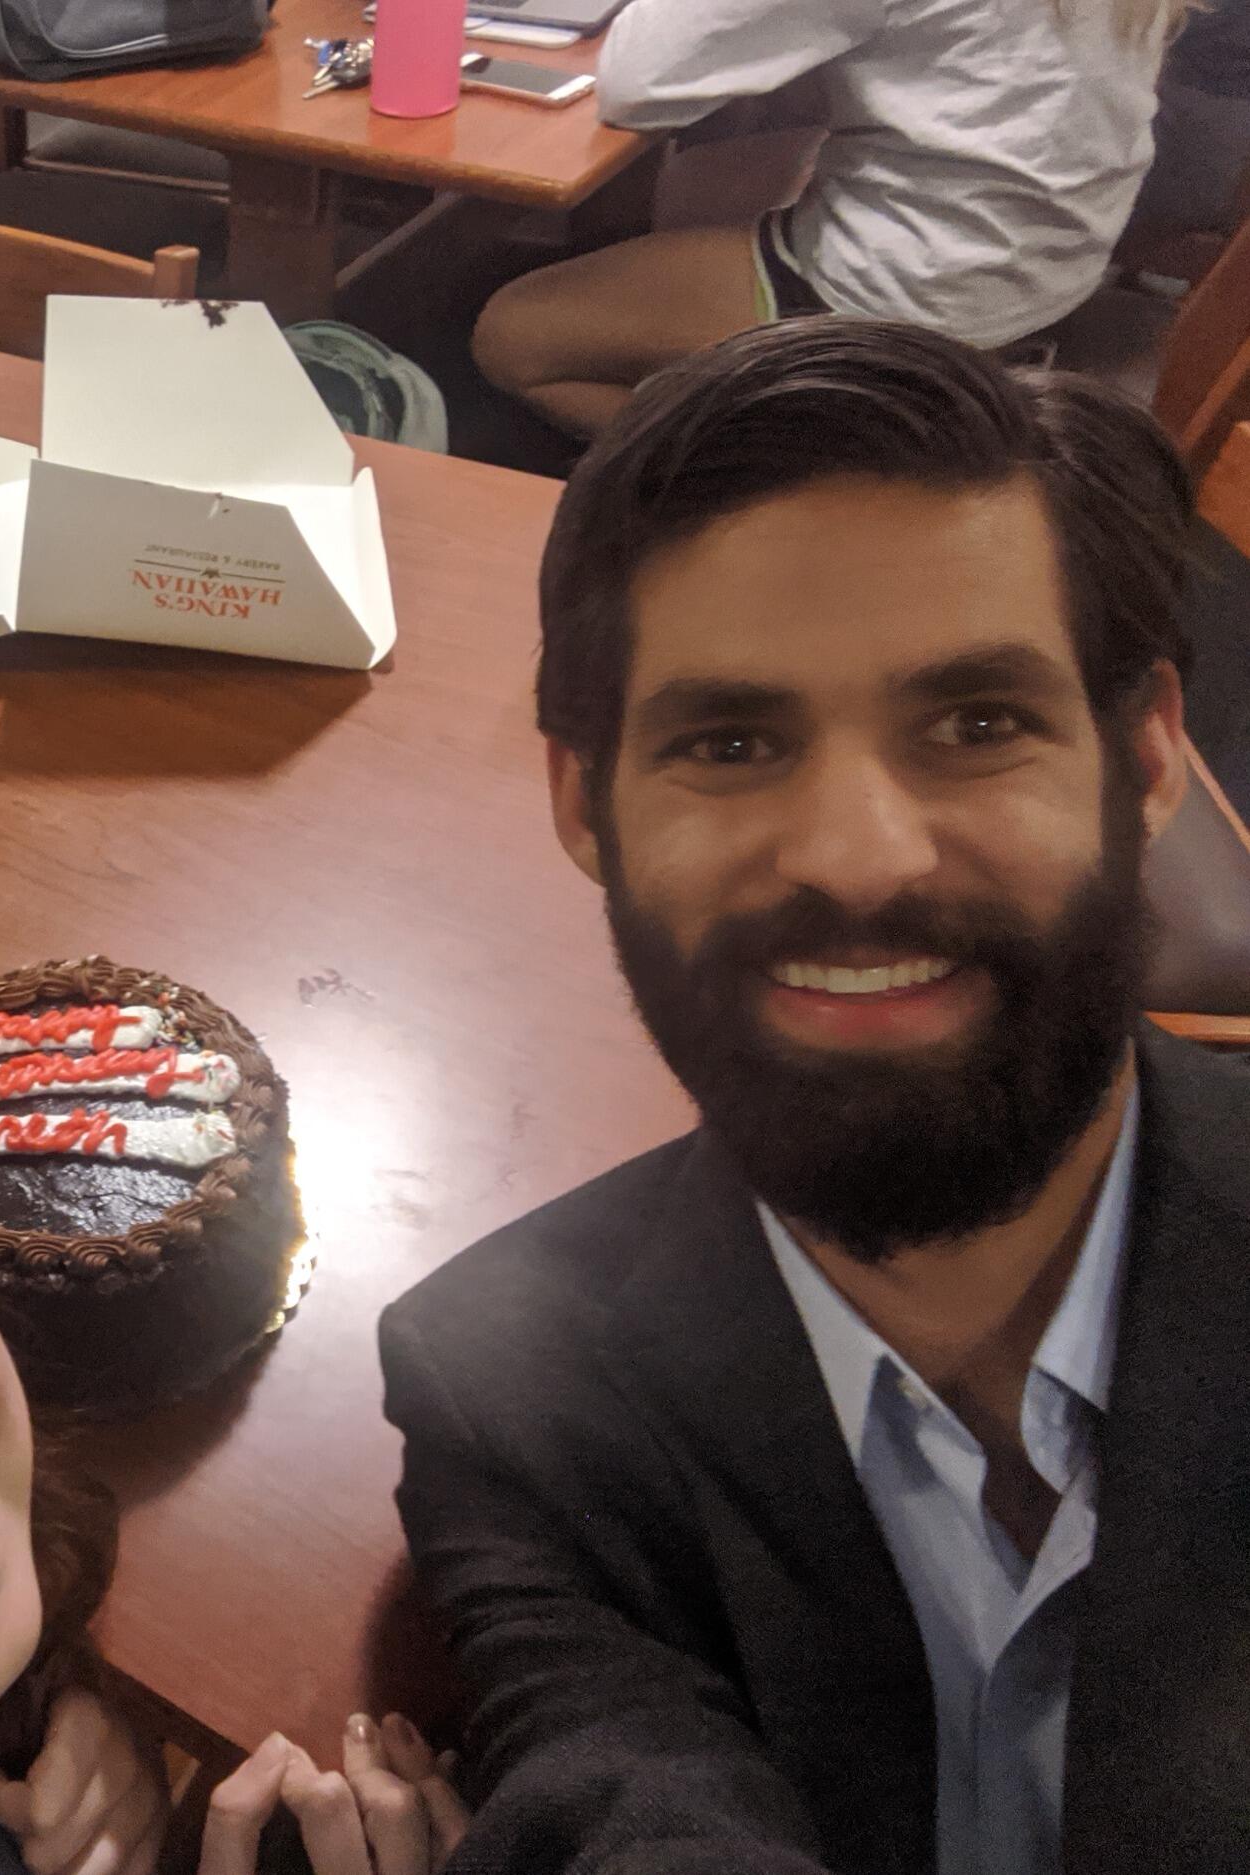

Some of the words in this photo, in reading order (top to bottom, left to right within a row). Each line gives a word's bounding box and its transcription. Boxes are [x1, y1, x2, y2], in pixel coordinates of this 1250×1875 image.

[145, 544, 219, 562] RESTAURANT
[223, 554, 232, 564] &
[236, 559, 281, 571] BAKERY
[132, 569, 282, 606] HAWAIIAN
[154, 593, 252, 619] KING'S
